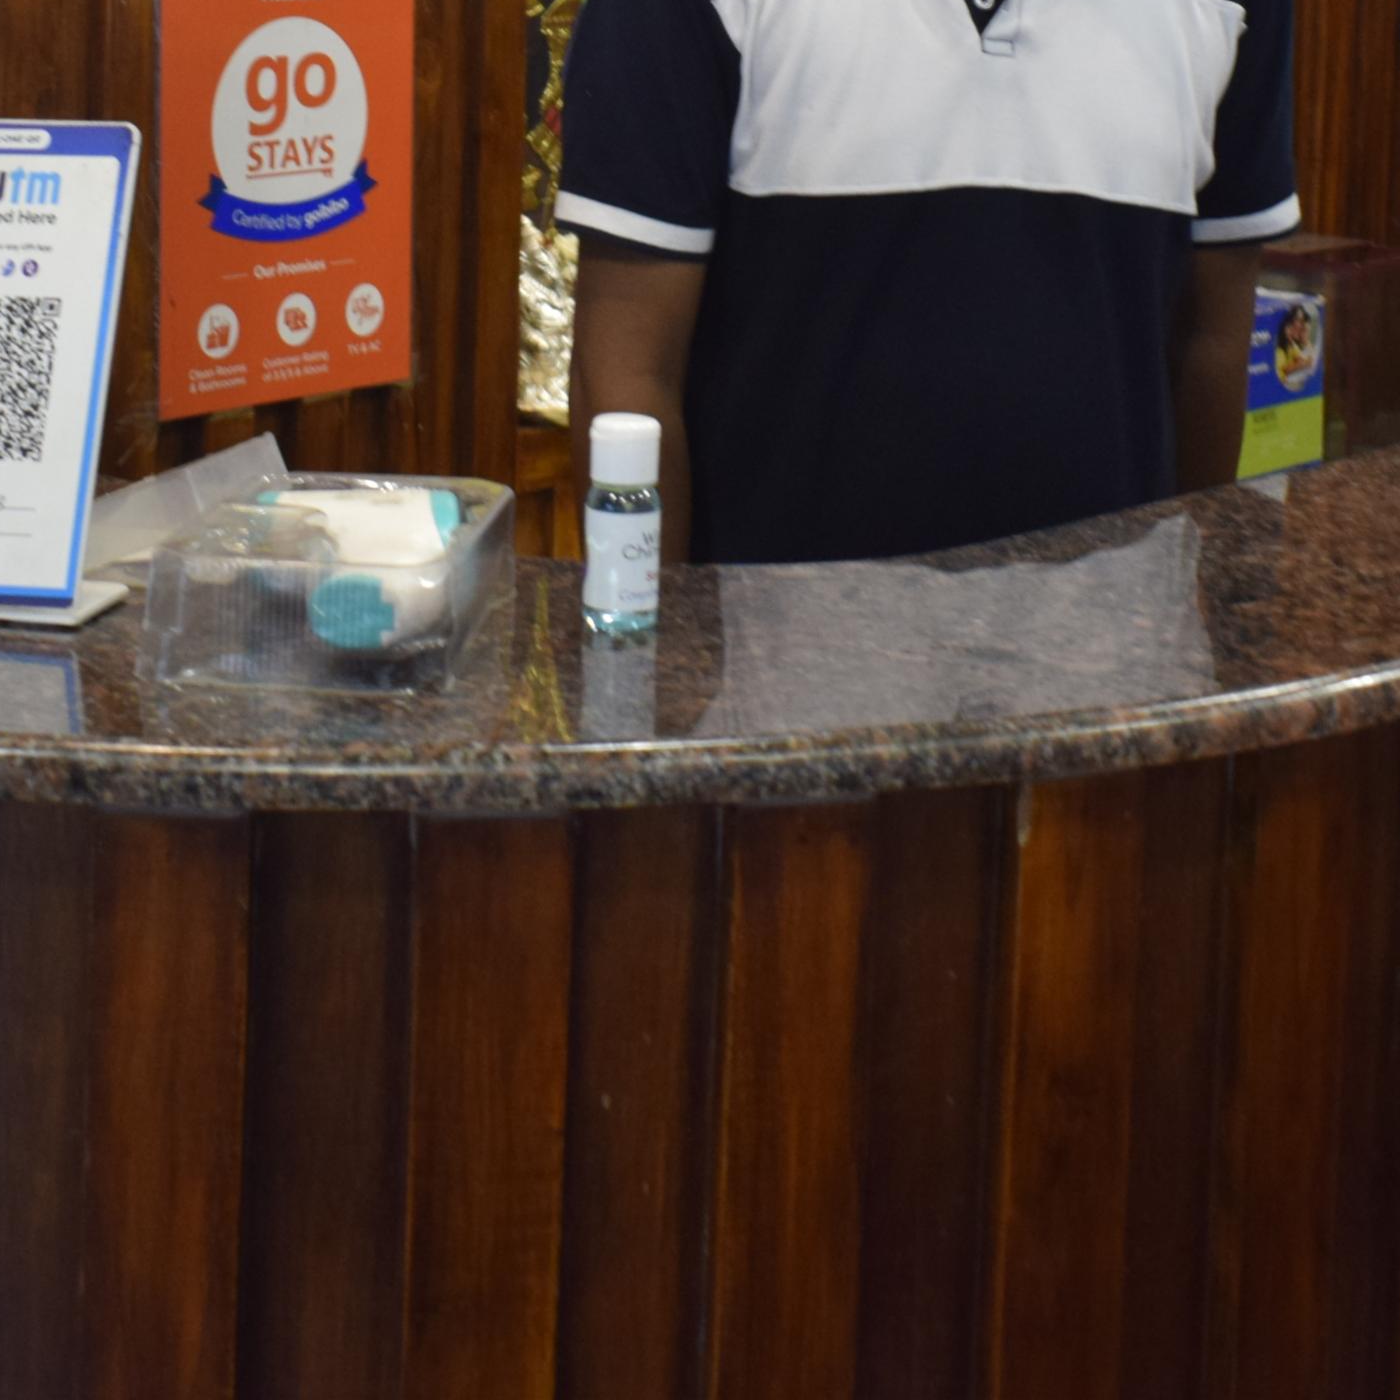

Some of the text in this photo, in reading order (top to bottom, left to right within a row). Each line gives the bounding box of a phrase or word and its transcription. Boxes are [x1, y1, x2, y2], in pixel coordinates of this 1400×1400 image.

[245, 51, 337, 138] go
[247, 134, 336, 172] STAYS
[18, 210, 57, 225] Here
[231, 208, 286, 232] Certified
[253, 263, 276, 279] Our
